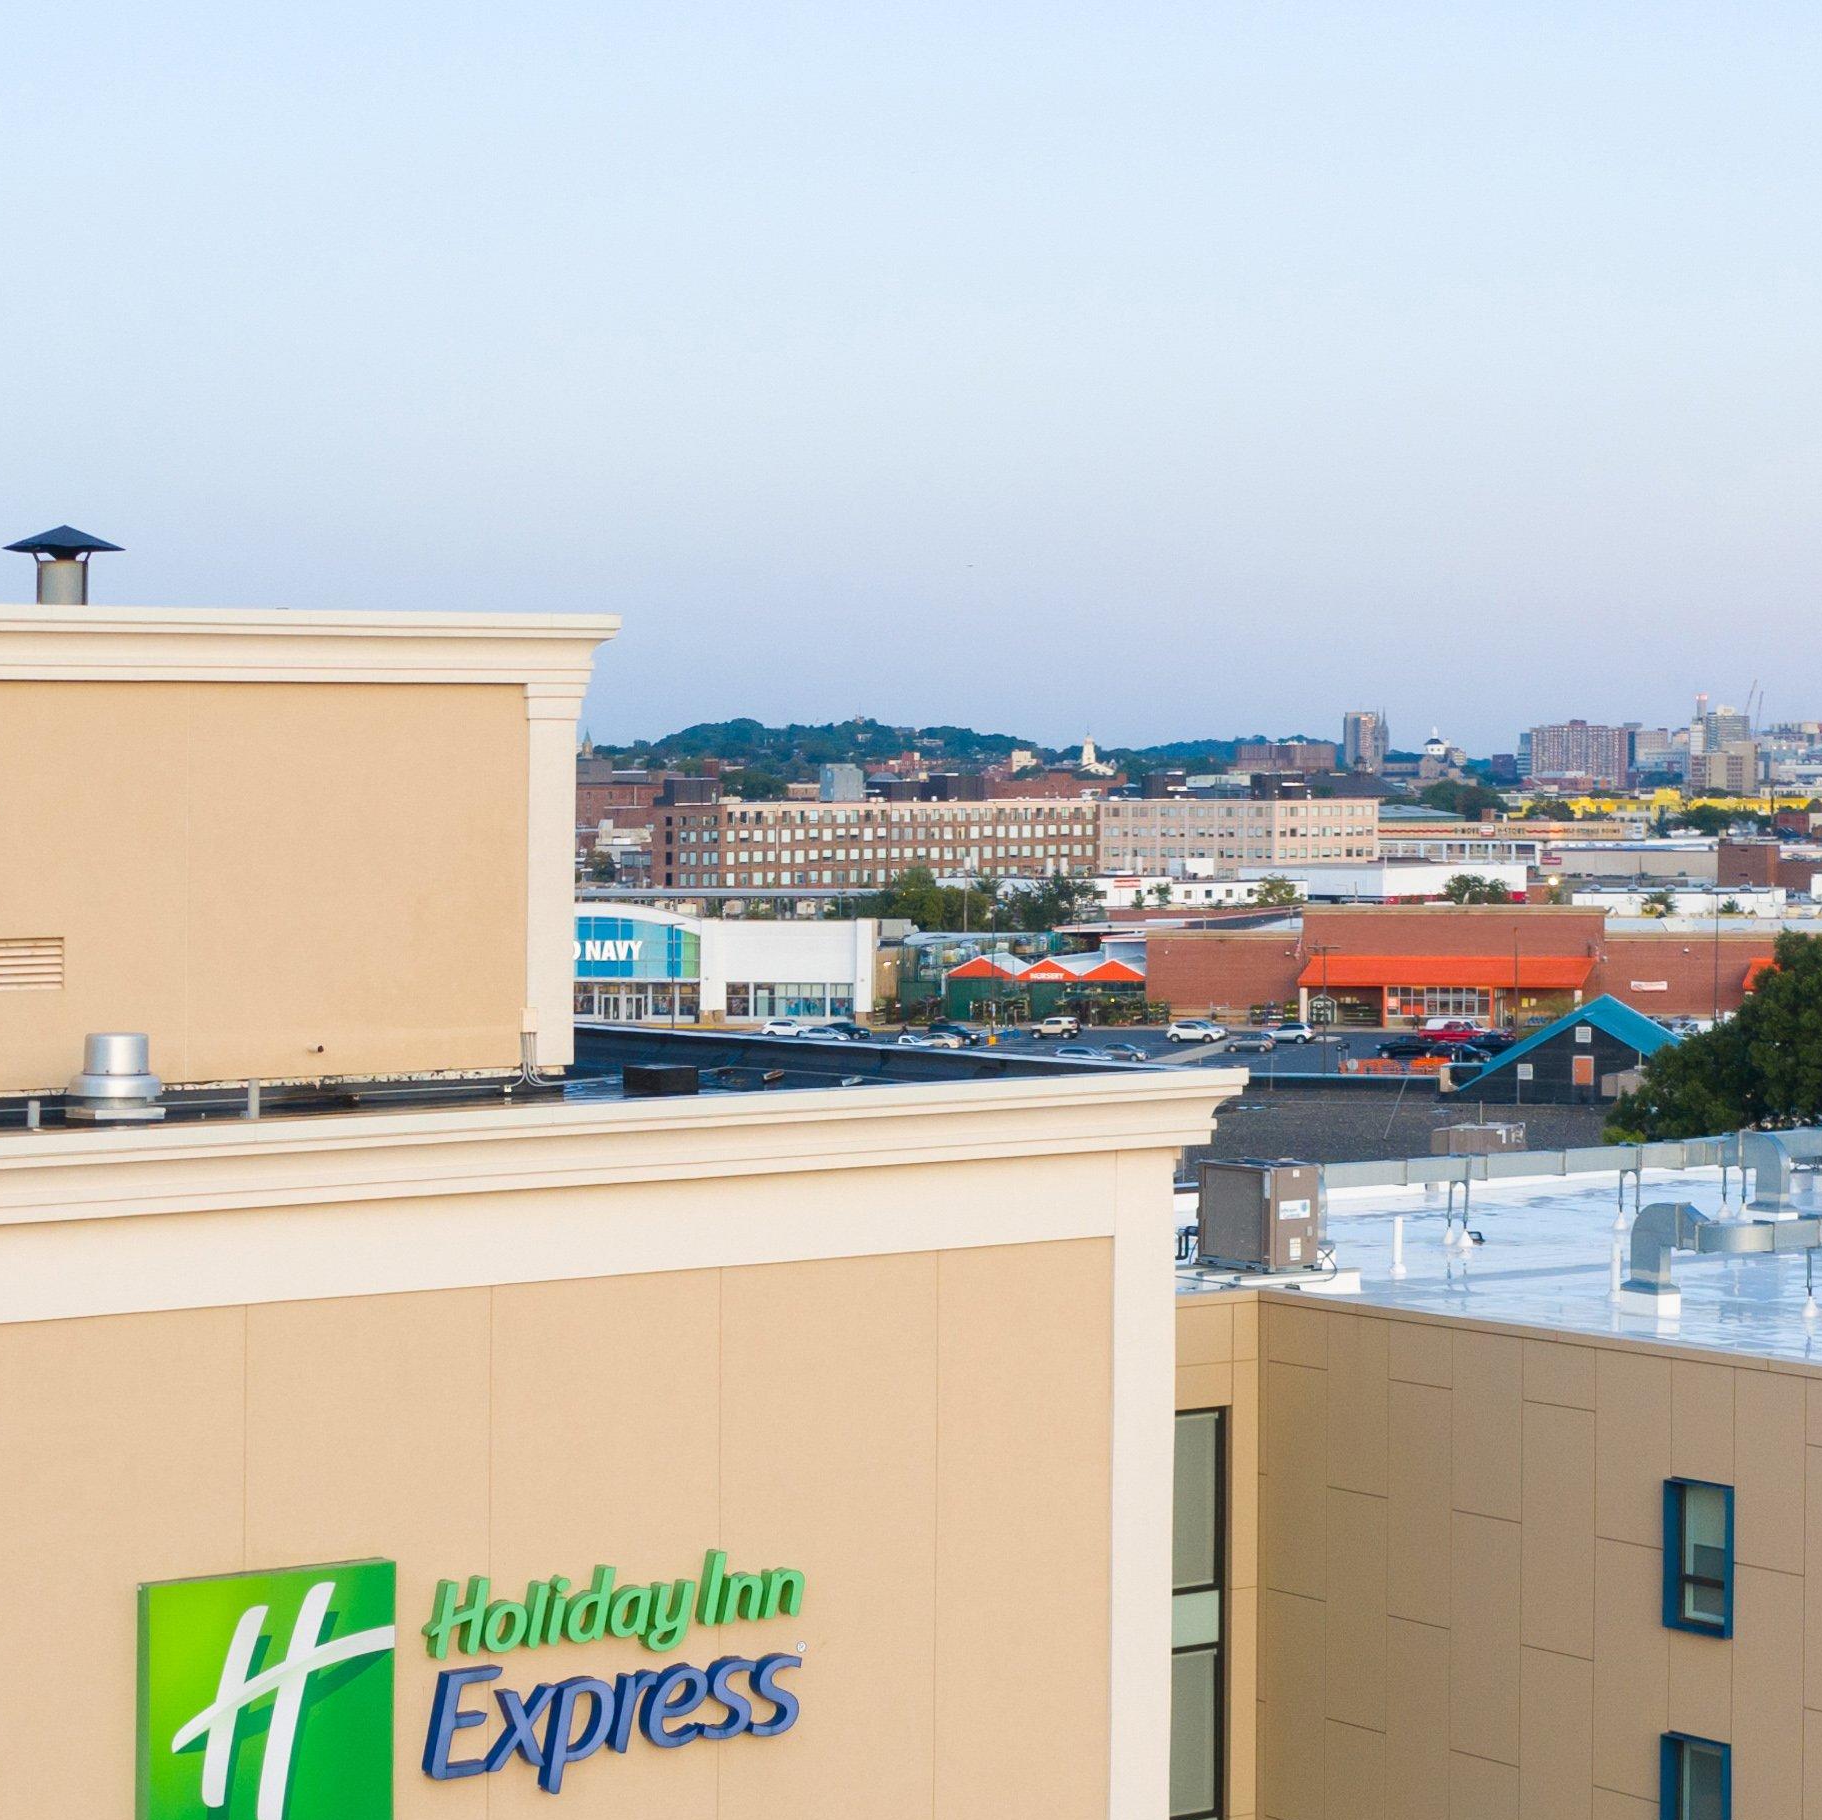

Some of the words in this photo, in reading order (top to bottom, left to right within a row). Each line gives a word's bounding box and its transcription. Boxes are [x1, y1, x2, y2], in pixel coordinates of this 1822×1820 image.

[585, 941, 643, 961] NAVY
[422, 1564, 695, 1659] Holiday
[695, 1548, 805, 1627] Inn
[421, 1652, 803, 1795] Express
